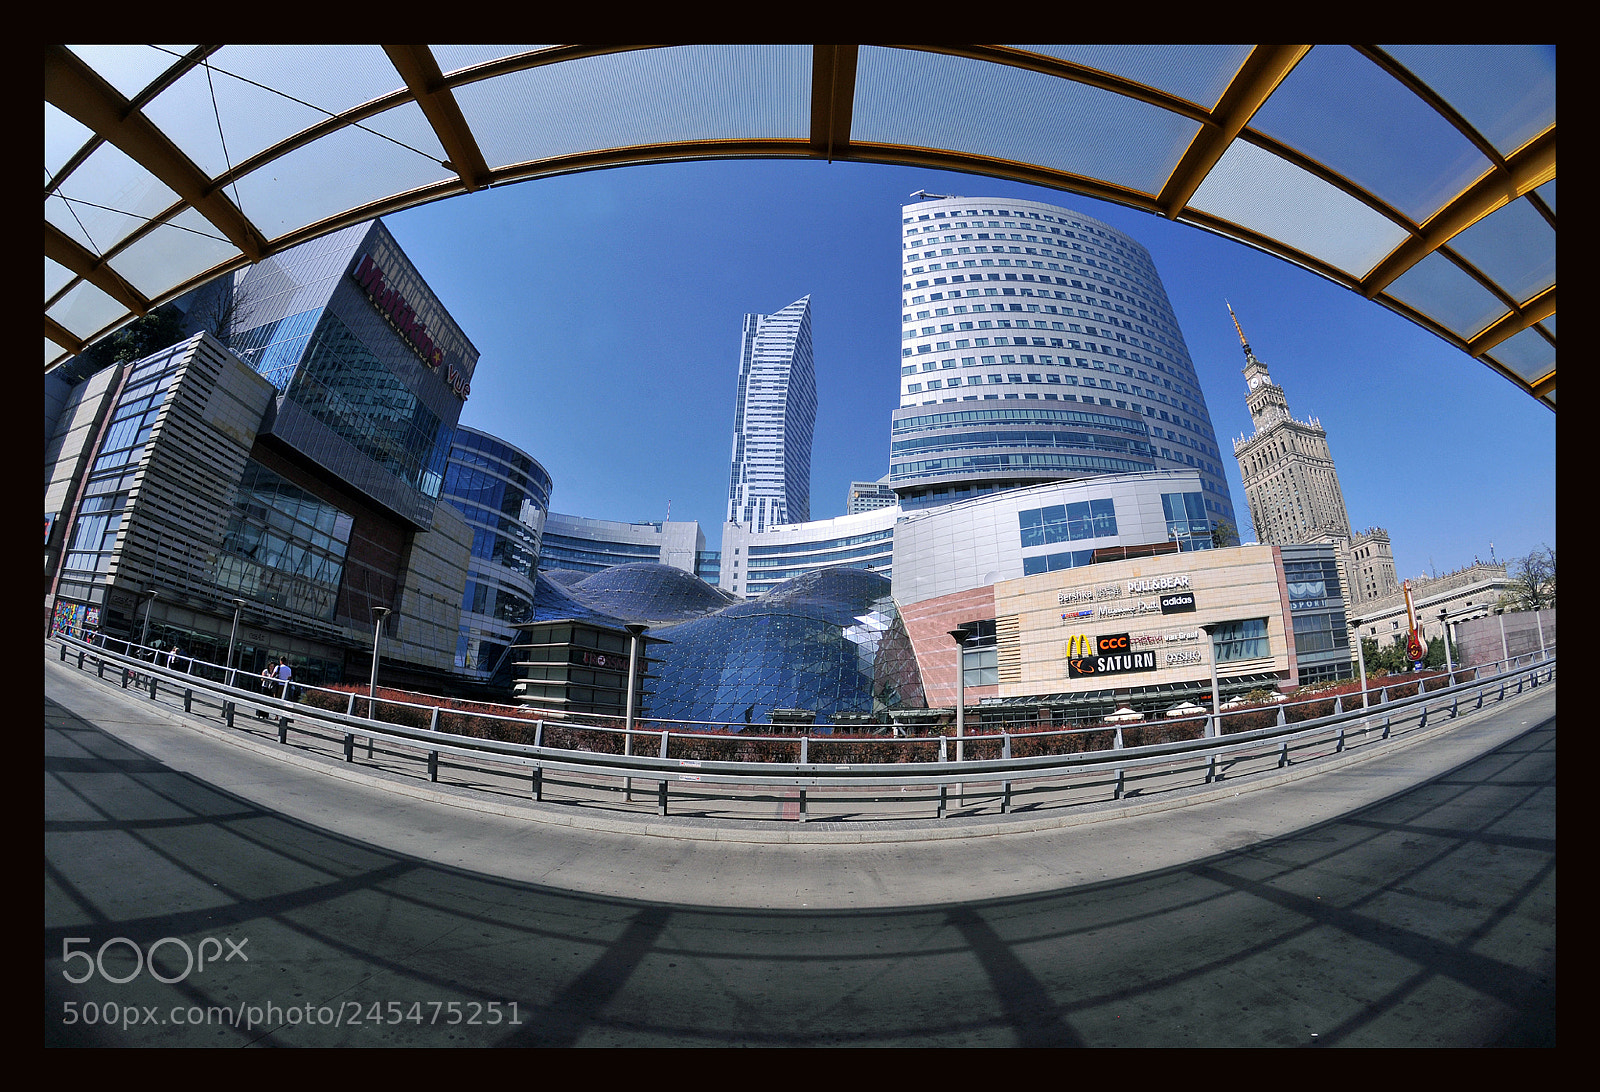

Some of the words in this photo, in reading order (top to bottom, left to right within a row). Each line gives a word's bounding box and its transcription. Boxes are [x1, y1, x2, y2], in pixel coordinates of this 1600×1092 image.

[1128, 576, 1189, 591] PULL&BEAR
[1058, 590, 1094, 602] Bershka
[1162, 597, 1193, 606] adidas
[1097, 652, 1154, 672] SATURN
